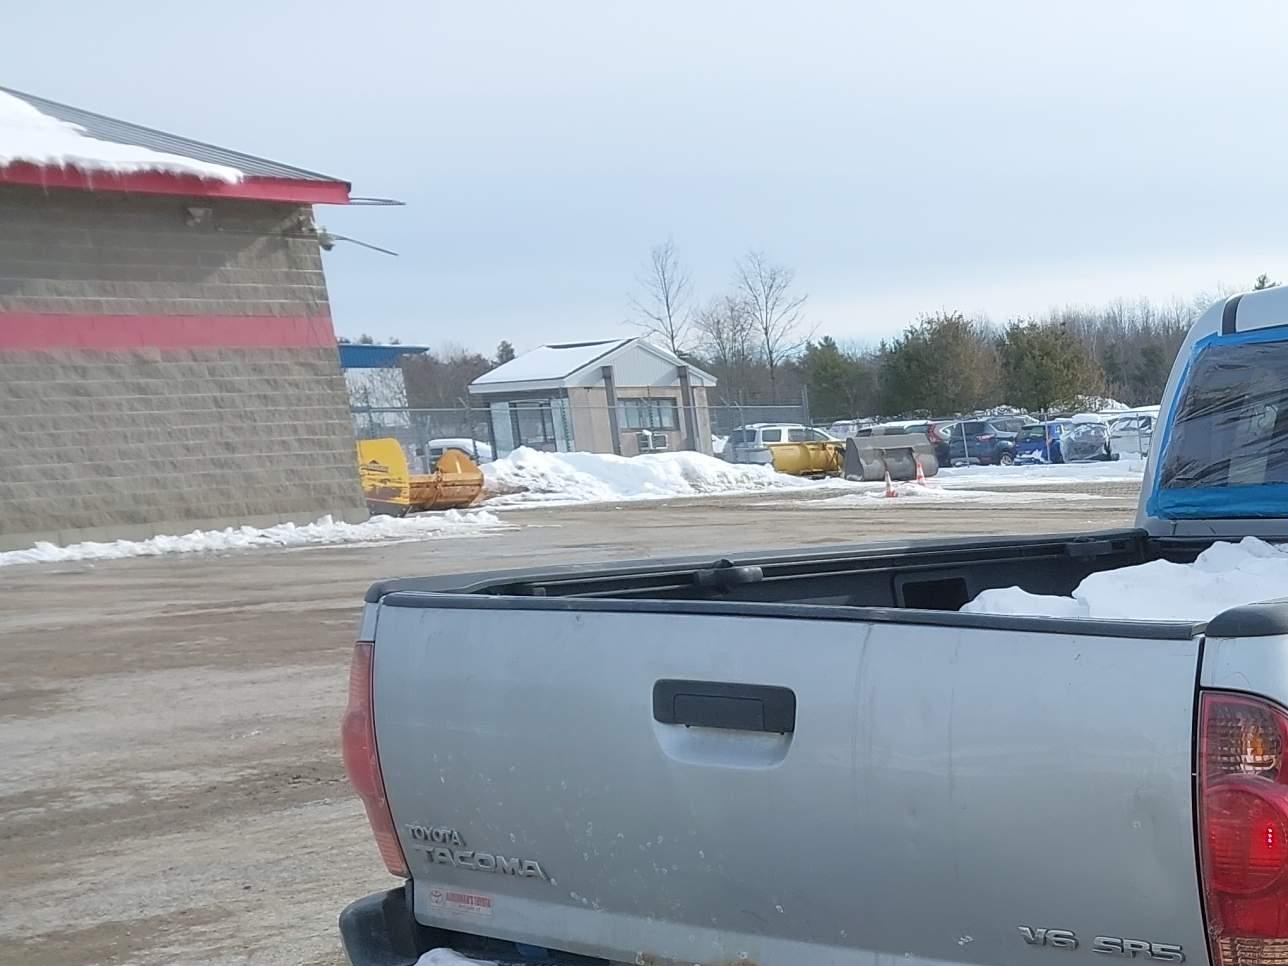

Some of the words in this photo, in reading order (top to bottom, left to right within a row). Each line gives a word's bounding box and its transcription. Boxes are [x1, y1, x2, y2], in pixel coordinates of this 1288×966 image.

[405, 823, 464, 847] TOYOTA
[413, 844, 550, 882] TACOMA
[1016, 924, 1079, 950] V6
[1091, 934, 1187, 964] SR5
